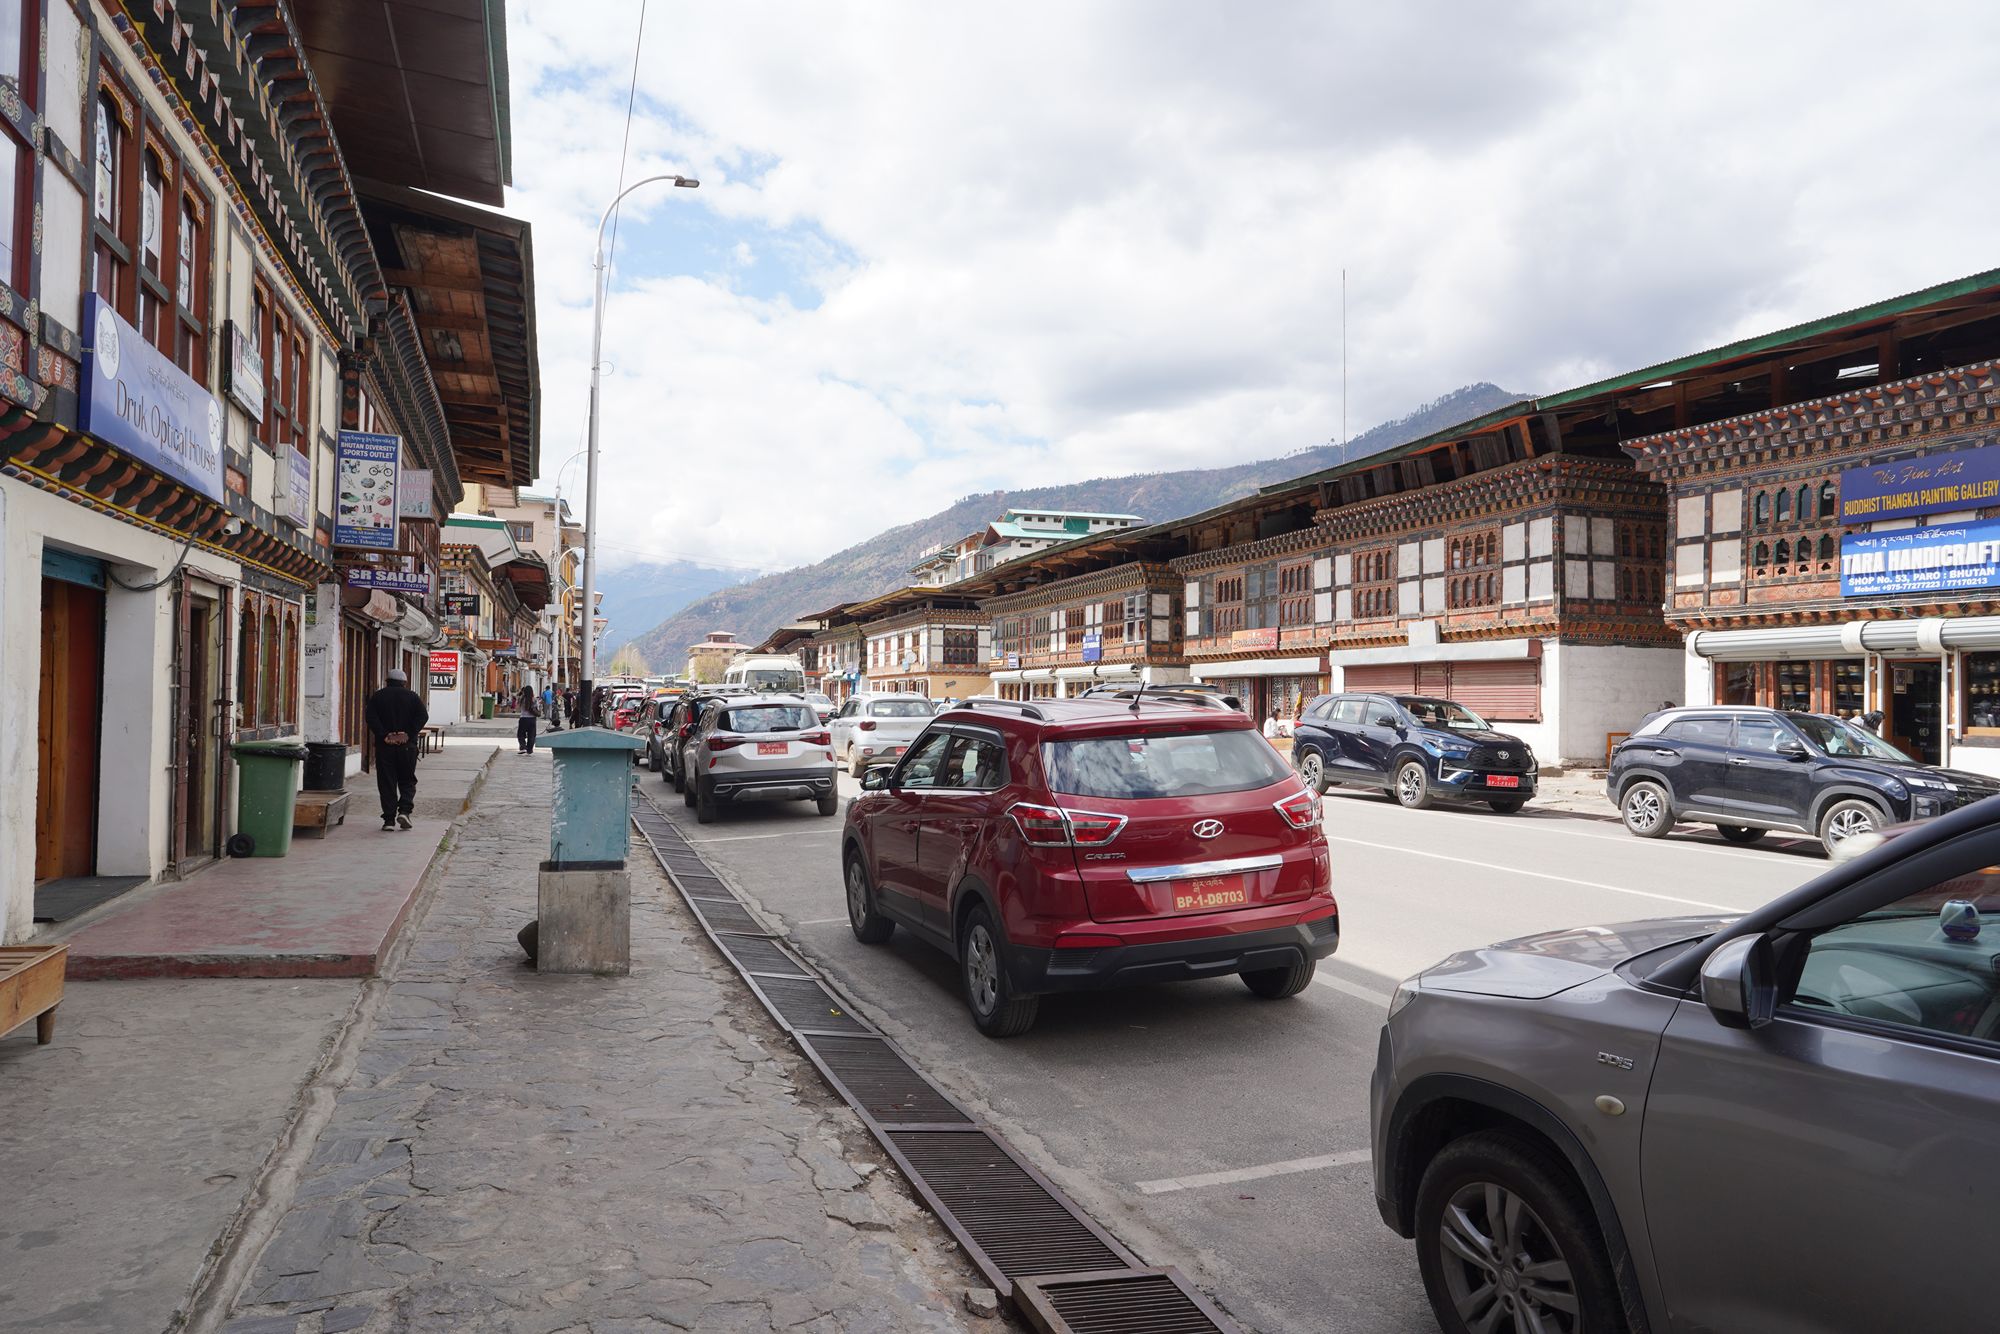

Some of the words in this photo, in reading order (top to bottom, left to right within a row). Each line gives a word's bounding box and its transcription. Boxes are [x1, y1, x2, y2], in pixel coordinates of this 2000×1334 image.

[116, 379, 148, 433] Druk
[151, 405, 187, 457] Optical
[190, 430, 216, 475] House
[344, 448, 368, 457] SPORTS
[366, 444, 396, 452] DIVERSITY
[1872, 469, 1896, 486] The
[1900, 466, 1931, 484] Fine
[1934, 460, 1964, 478] Art
[1844, 496, 1880, 516] BUDDHIST
[1881, 490, 1920, 510] THANGKA
[1920, 485, 1959, 506] PAINTING
[1961, 480, 2000, 500] GALLERY
[1842, 551, 1886, 576] TARA
[1888, 540, 2000, 572] HANDICRAFT
[348, 569, 372, 580] SR
[376, 570, 429, 584] SALON
[1848, 576, 1874, 586] SHOP
[1877, 575, 1892, 584] No.
[1896, 574, 1910, 584] 53,
[1913, 572, 1940, 581] PARO
[1950, 566, 1996, 578] BHUTAN
[1854, 585, 1880, 593] Mobile:
[1946, 577, 1988, 586] 77170213
[430, 675, 454, 685] URANT
[1085, 852, 1126, 860] CRETA
[1176, 890, 1244, 909] BP-1-D8703
